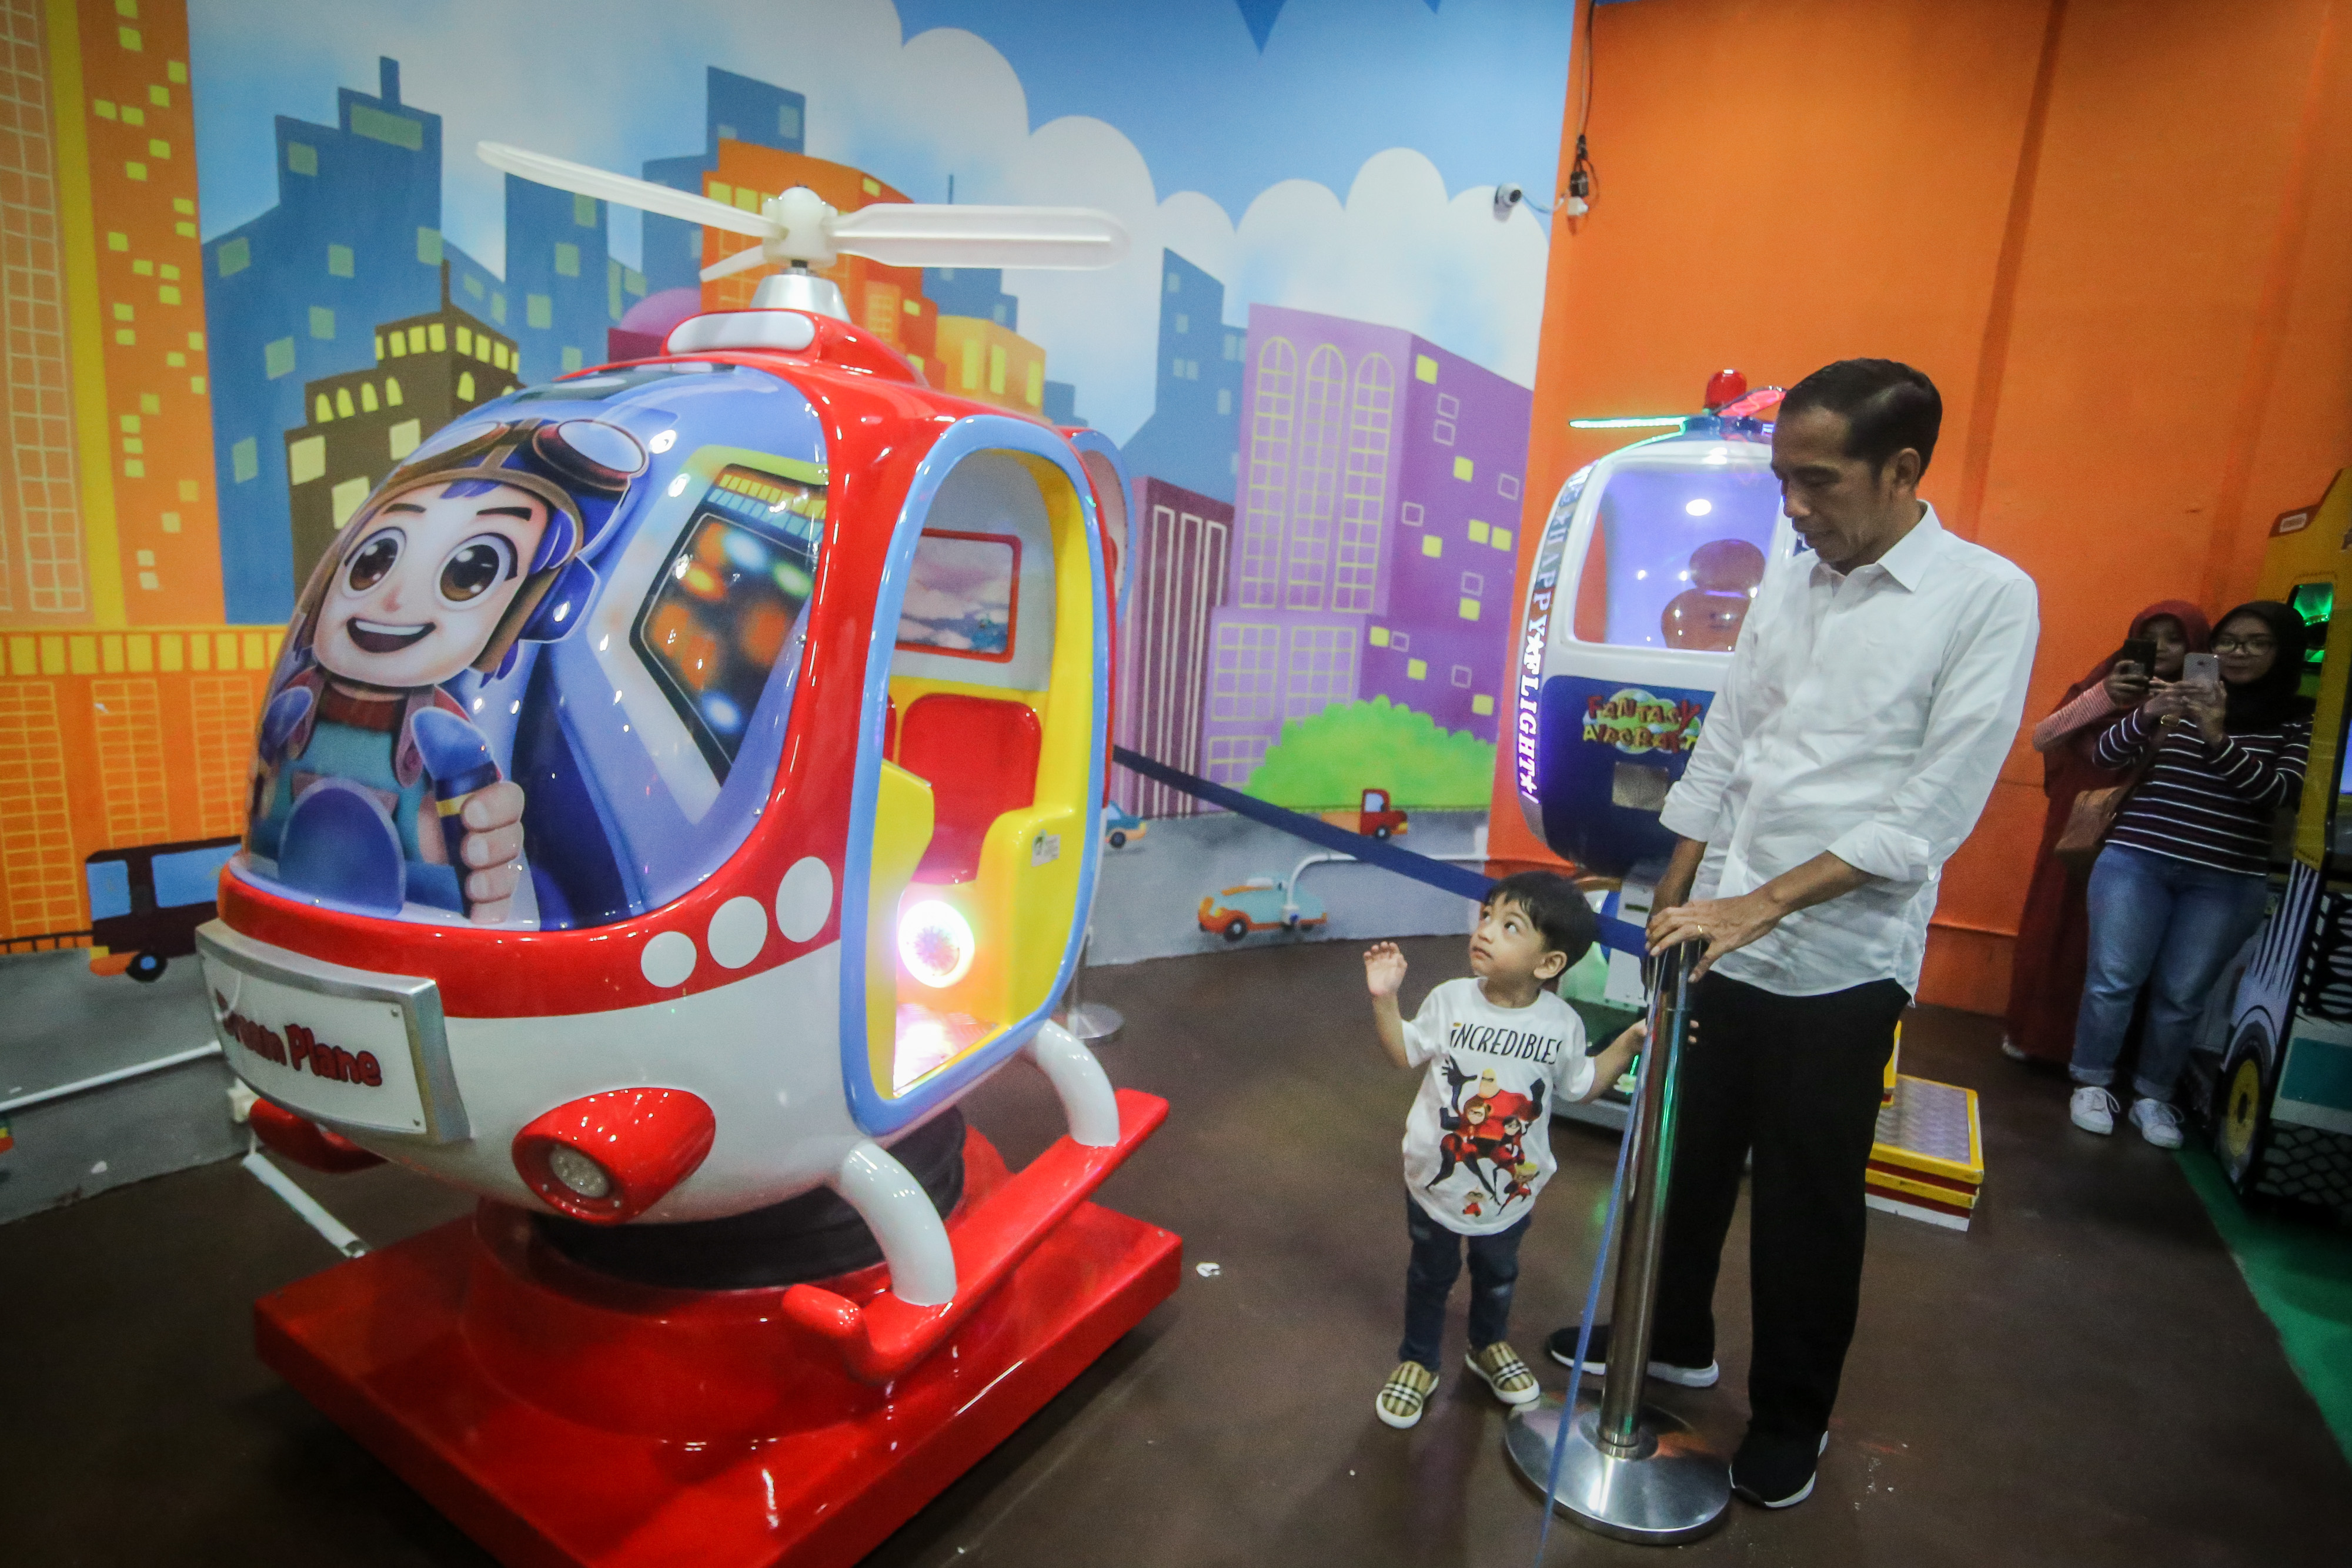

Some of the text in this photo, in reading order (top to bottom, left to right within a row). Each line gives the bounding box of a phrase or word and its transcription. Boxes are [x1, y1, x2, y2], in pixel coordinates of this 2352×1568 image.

[1518, 651, 1542, 777] FLIGHT
[1588, 695, 1702, 733] FANTASY
[284, 1023, 383, 1086] Plane
